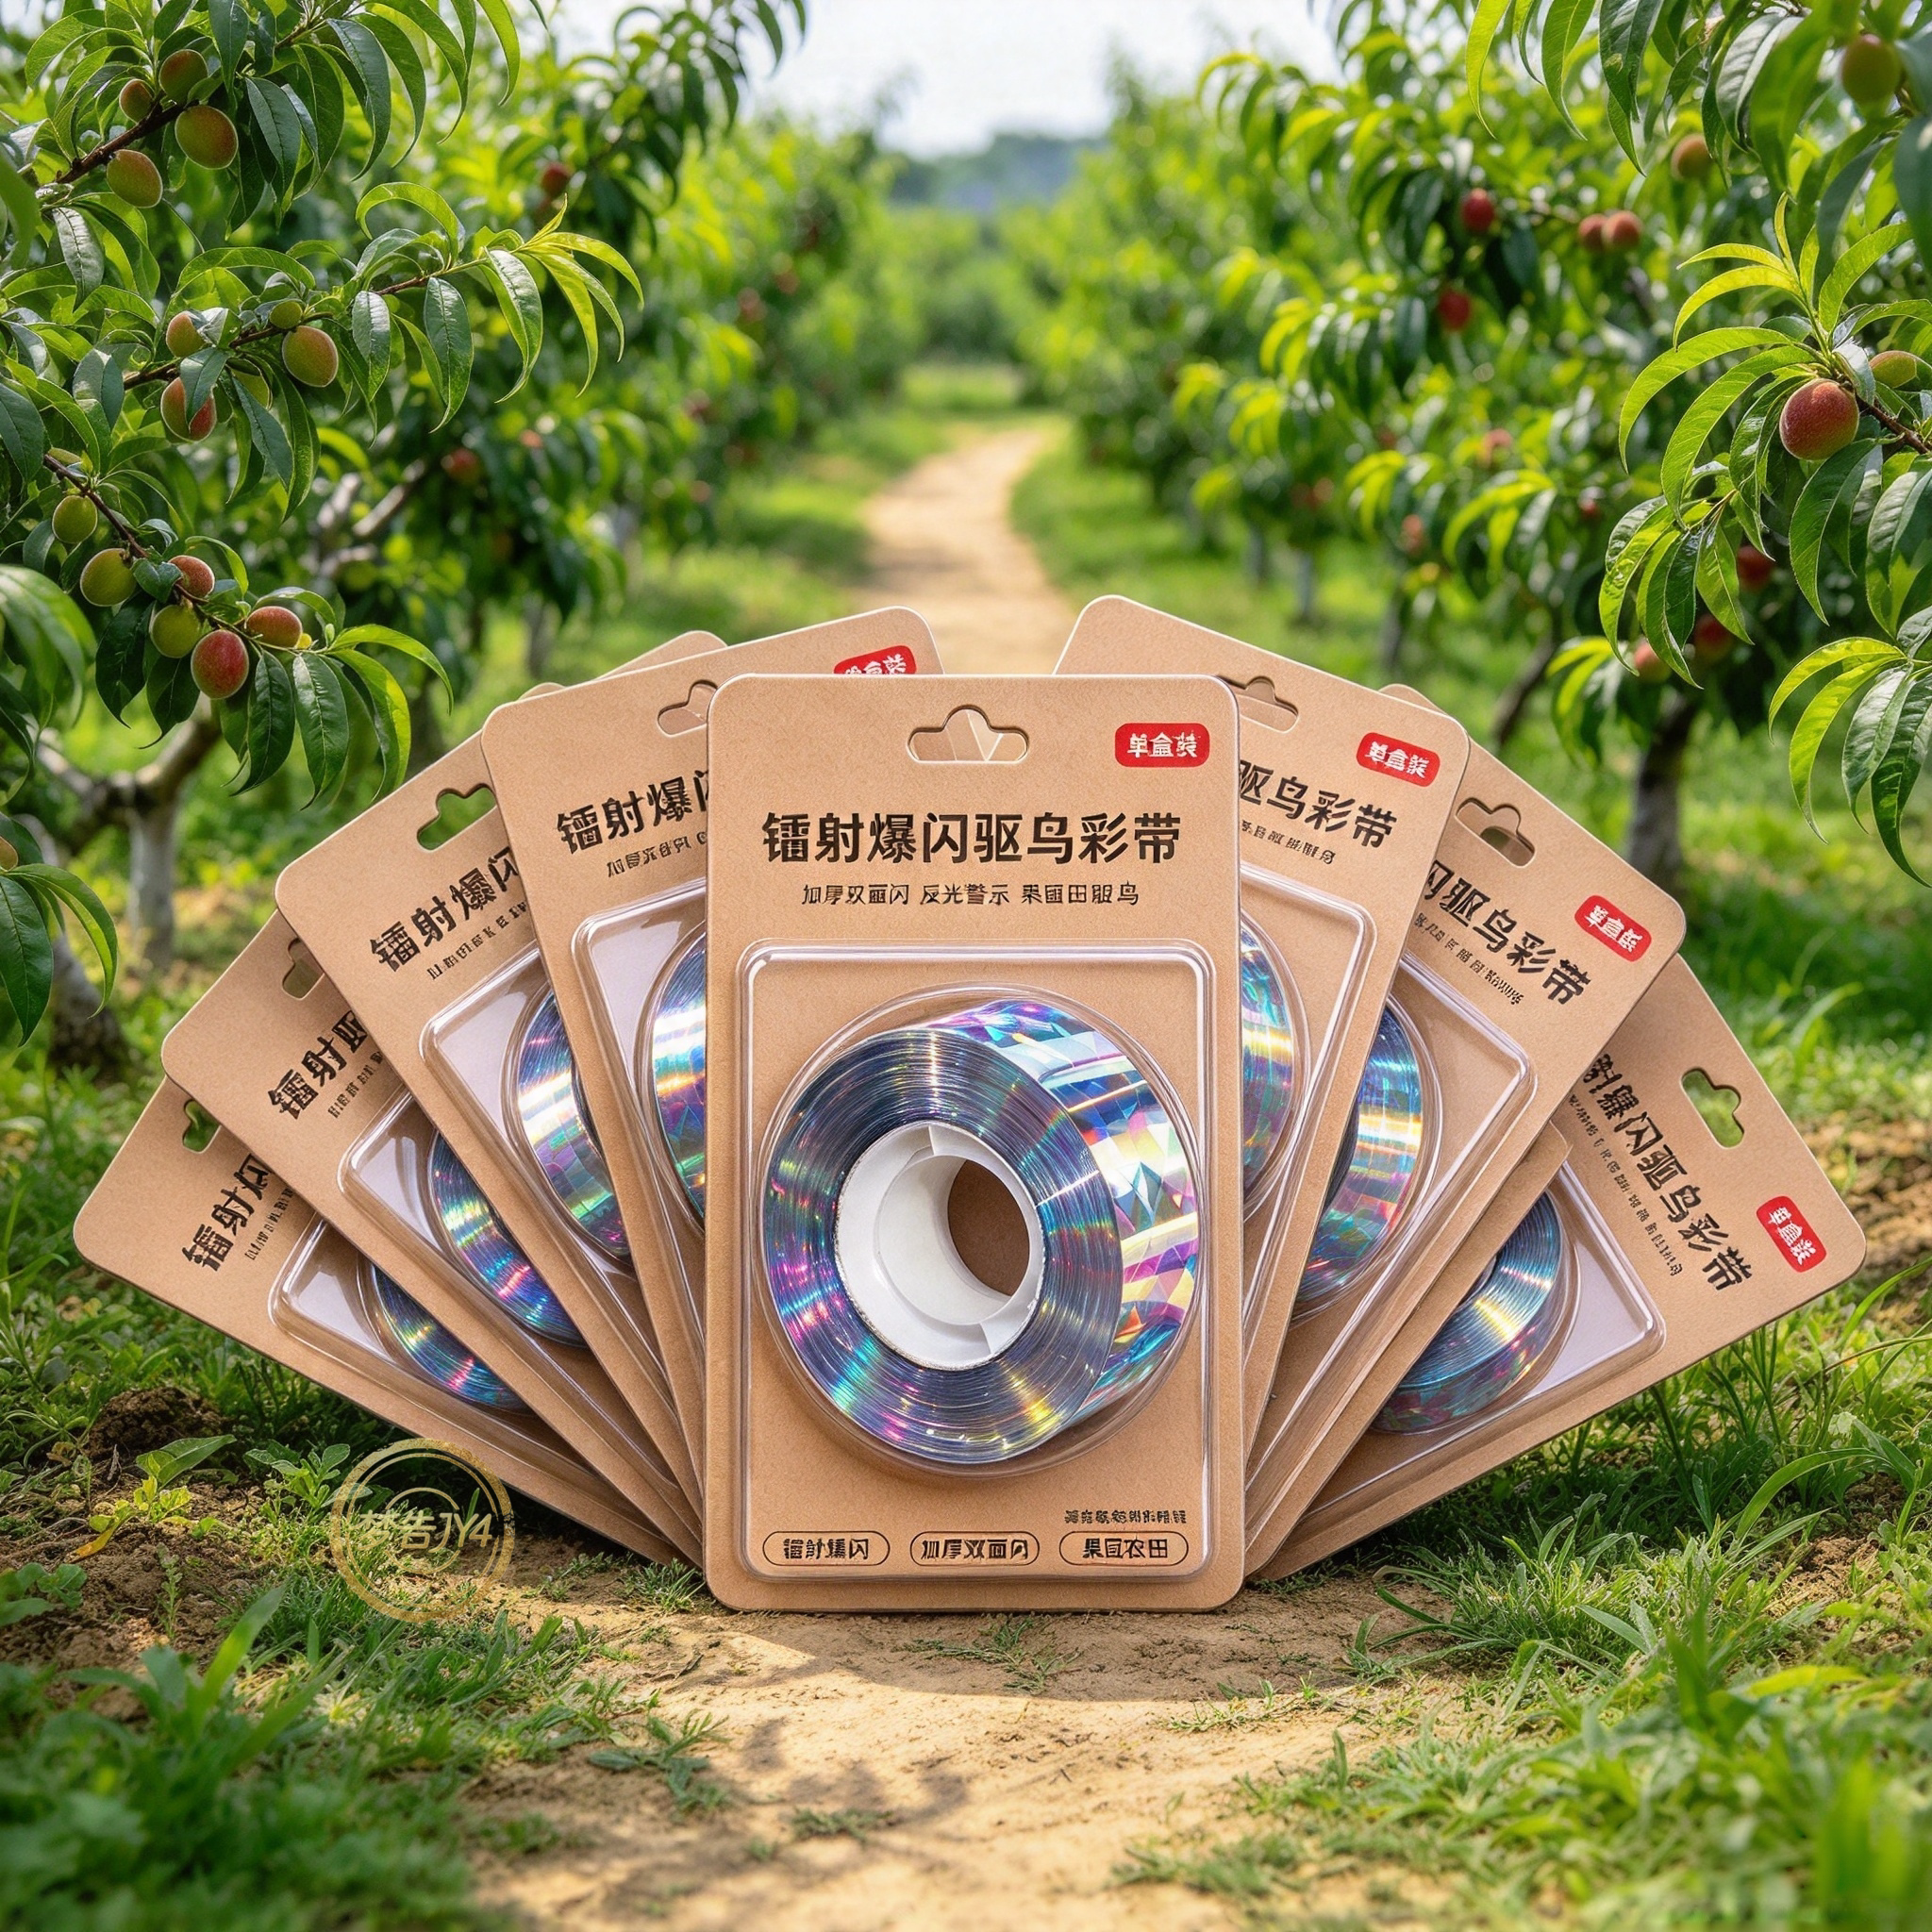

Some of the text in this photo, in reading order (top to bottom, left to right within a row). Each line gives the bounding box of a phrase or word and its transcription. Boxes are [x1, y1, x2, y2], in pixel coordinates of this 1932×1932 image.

[761, 812, 1181, 864] 镭射爆闪驱鸟彩带
